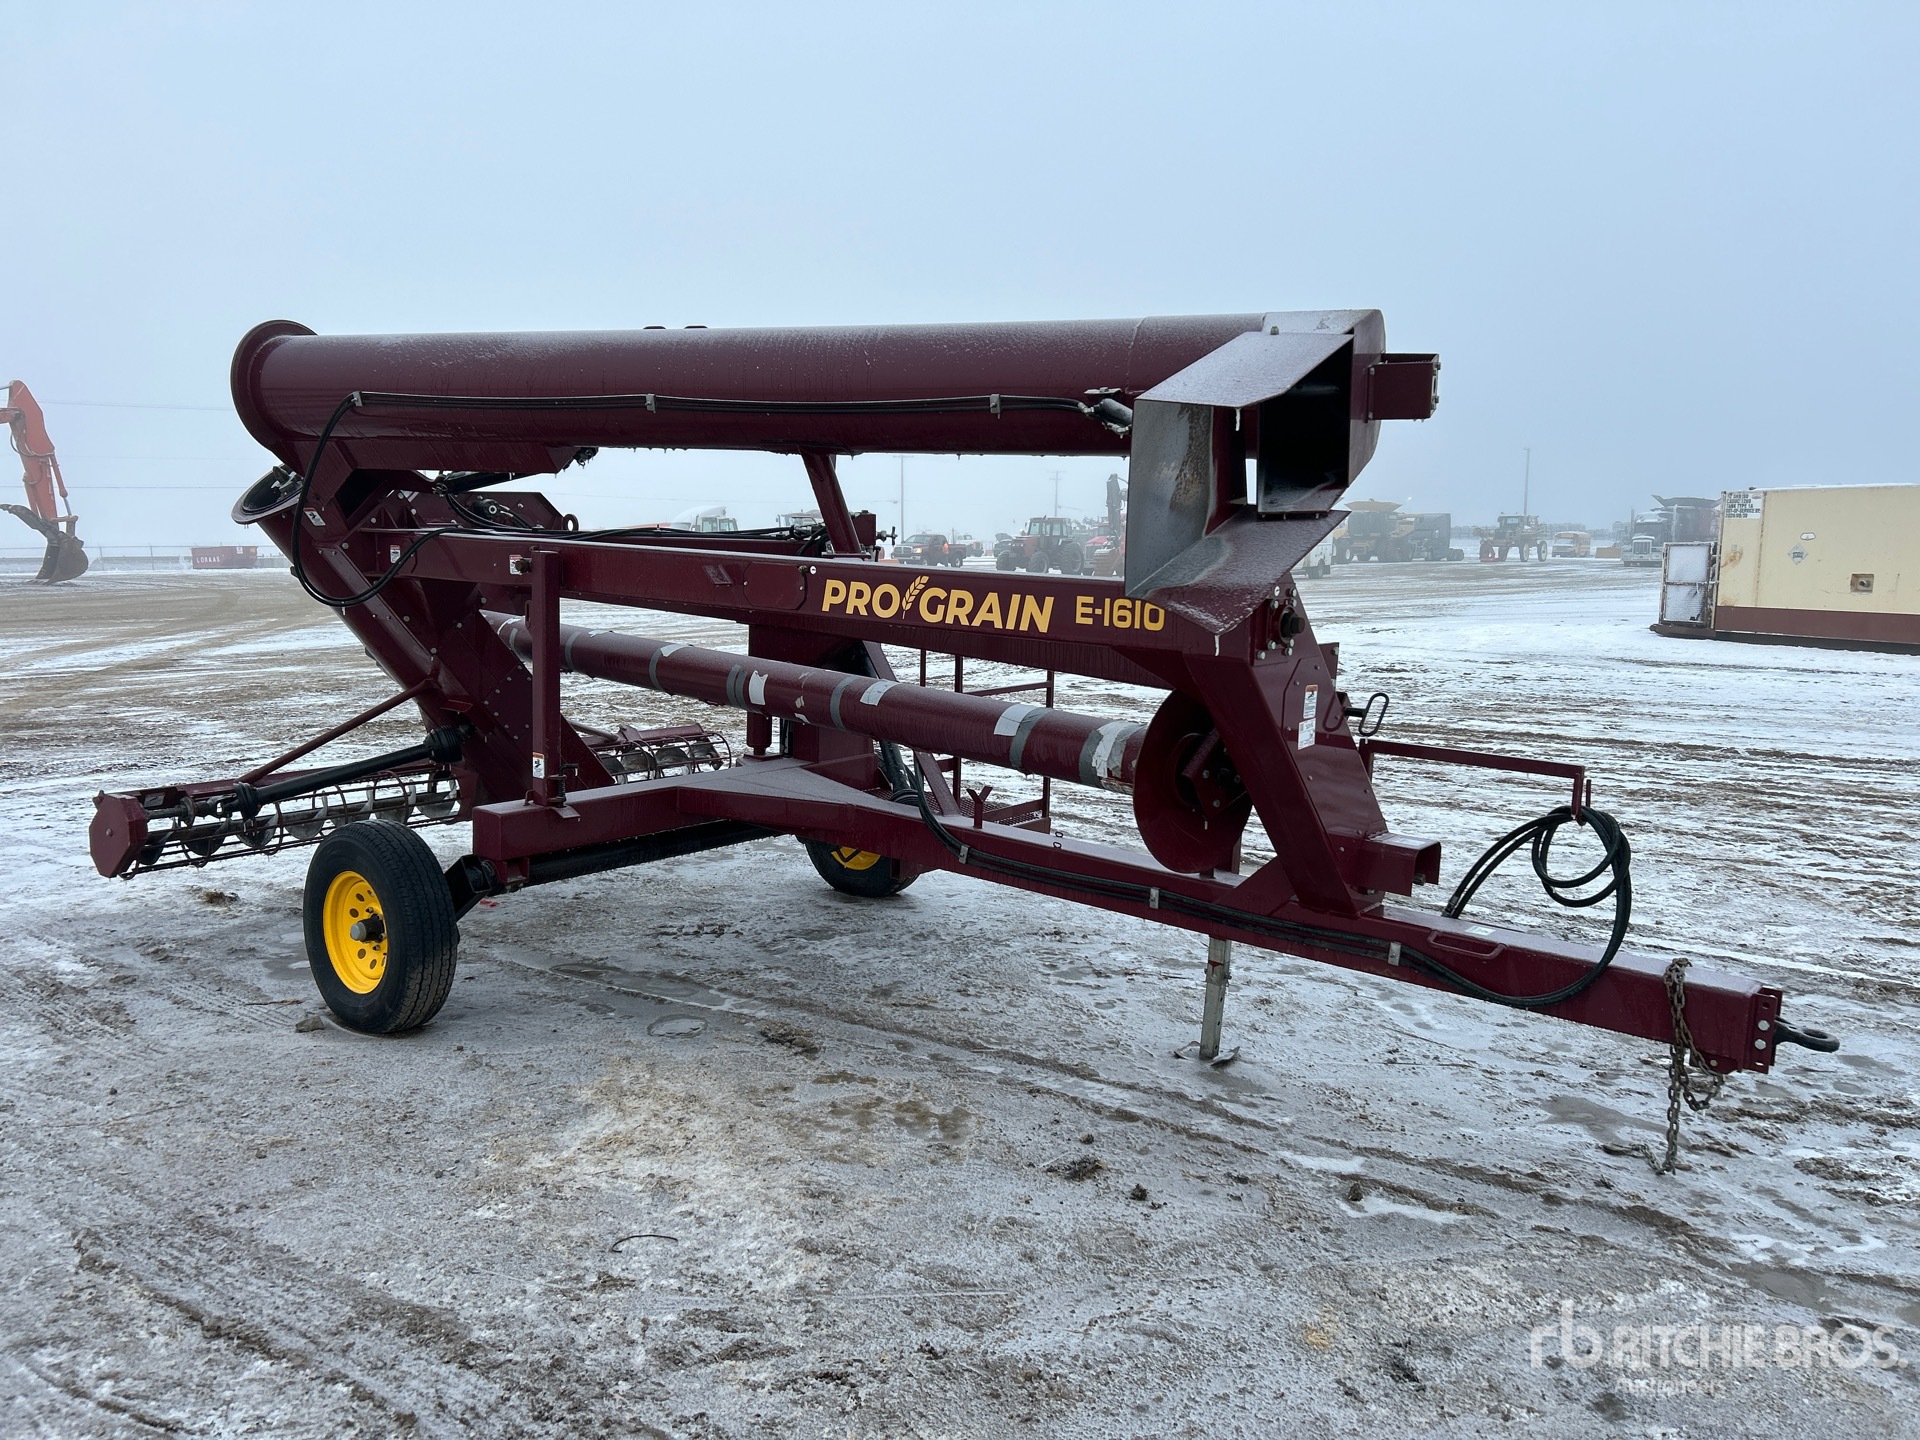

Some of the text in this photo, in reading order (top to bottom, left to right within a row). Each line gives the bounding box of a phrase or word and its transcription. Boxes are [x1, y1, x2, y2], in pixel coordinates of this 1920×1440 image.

[822, 579, 1166, 633] PRO GRAIN E-1610
